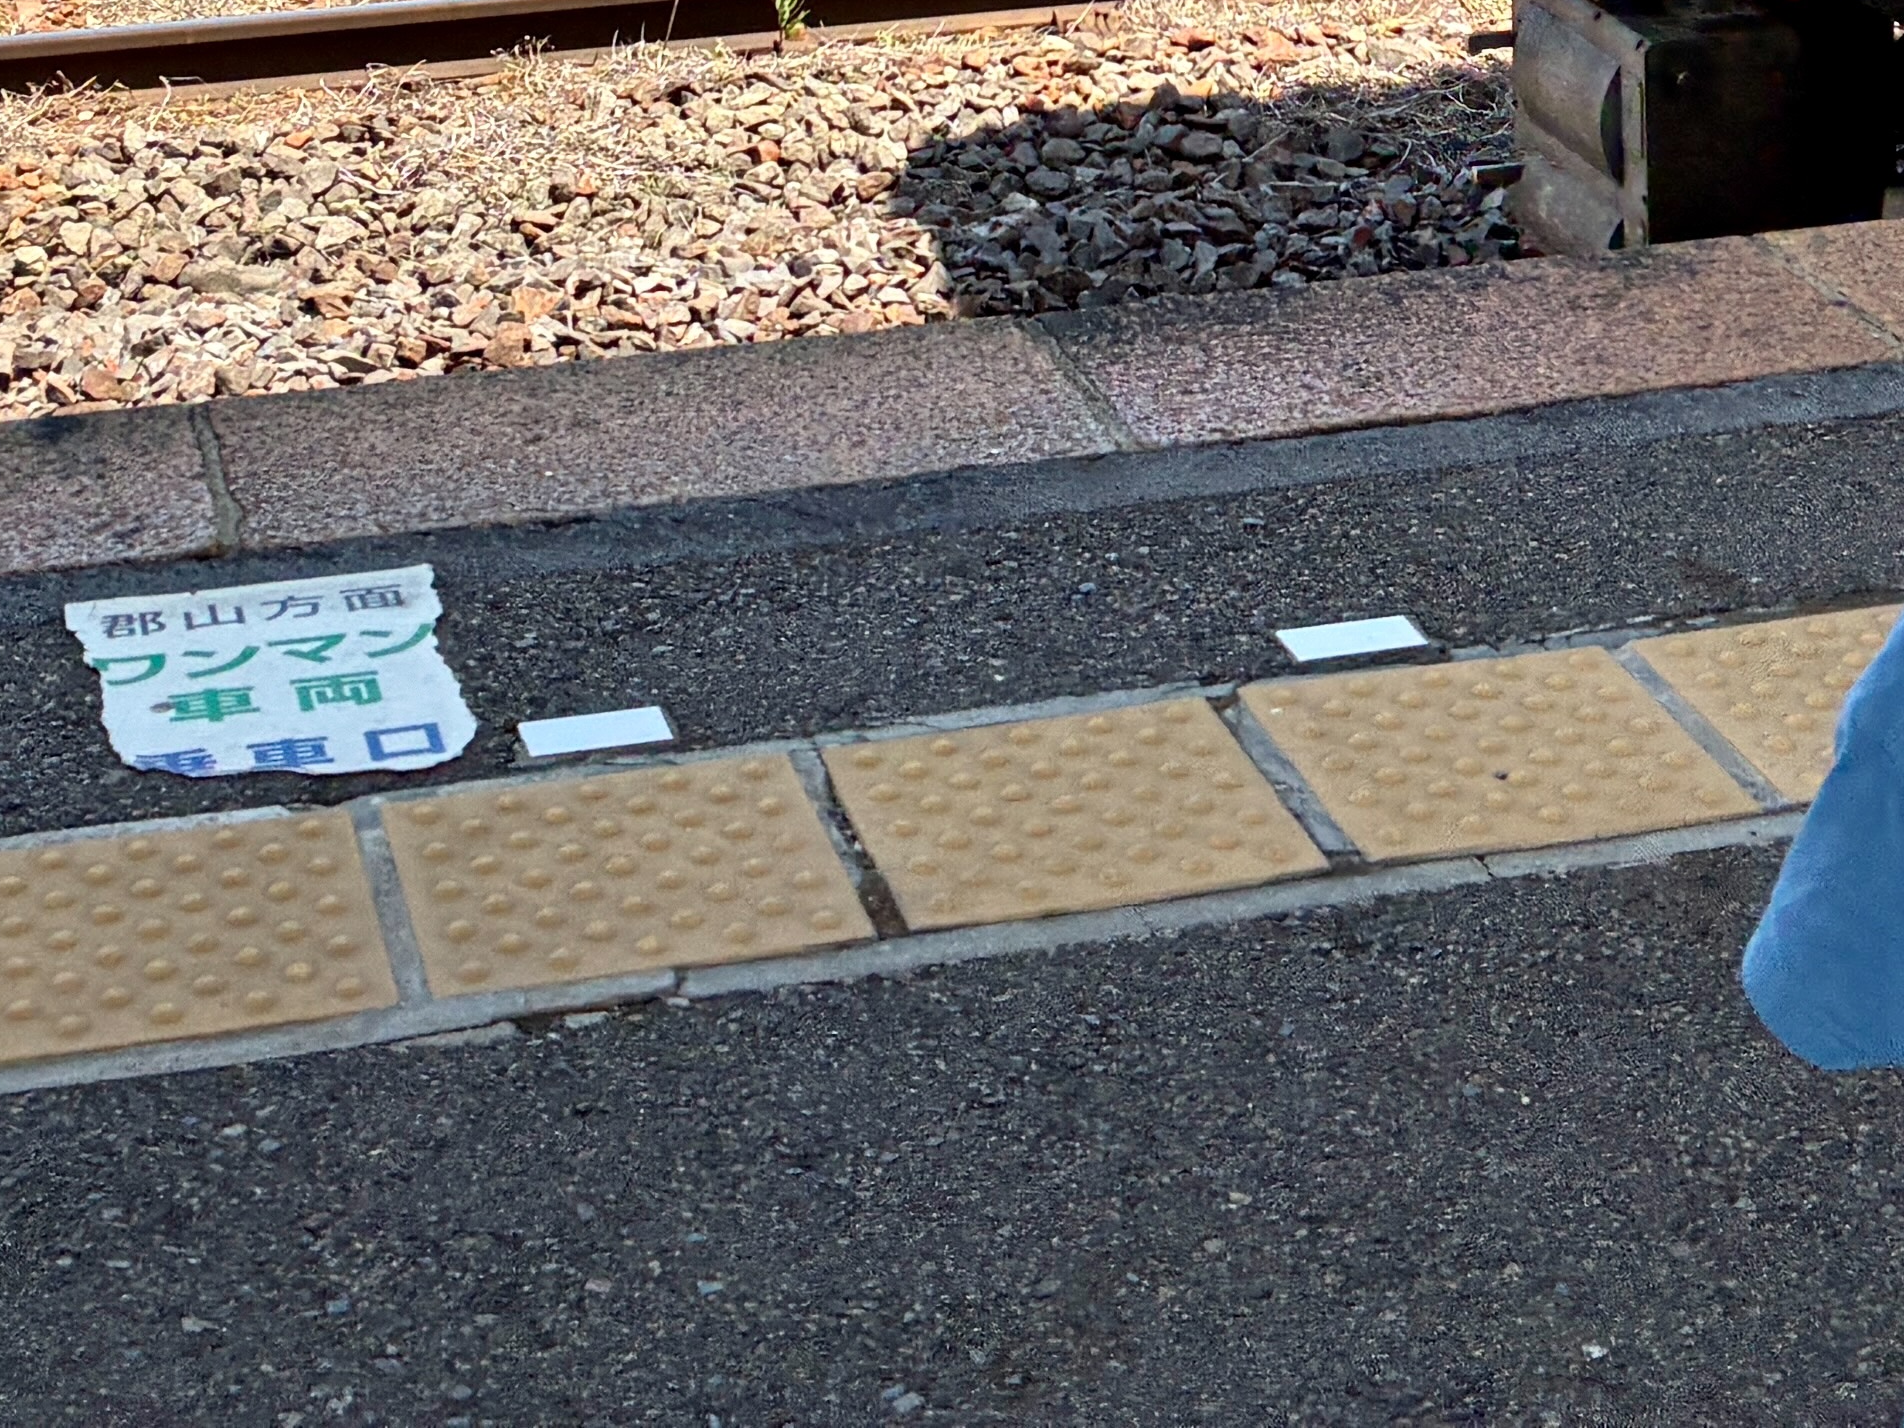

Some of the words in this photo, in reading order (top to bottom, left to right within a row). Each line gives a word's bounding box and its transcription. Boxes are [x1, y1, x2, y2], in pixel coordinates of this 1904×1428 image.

[101, 584, 405, 638] 郡山方面
[92, 623, 435, 685] ワンマン
[168, 670, 383, 721] 車両
